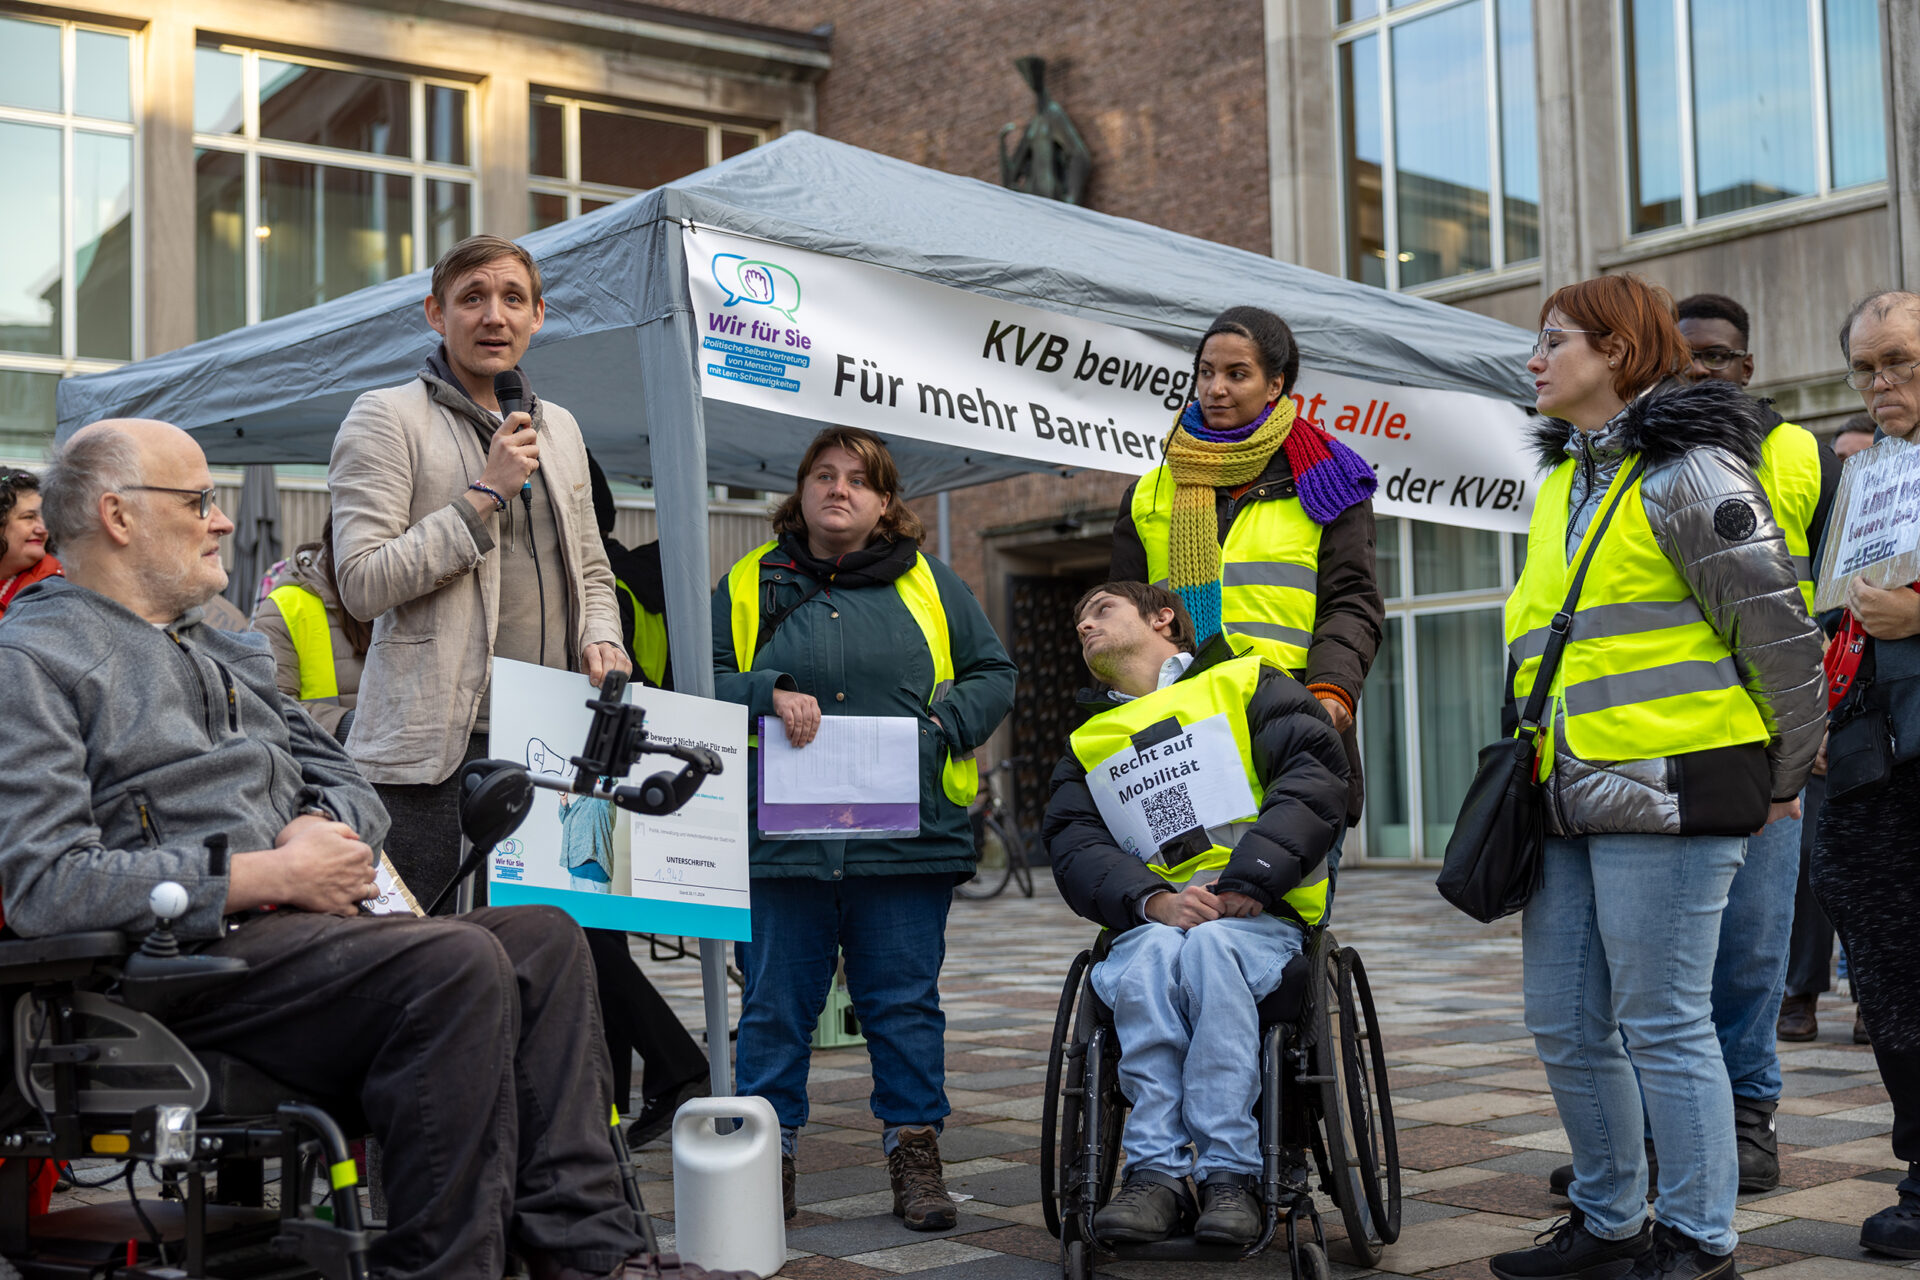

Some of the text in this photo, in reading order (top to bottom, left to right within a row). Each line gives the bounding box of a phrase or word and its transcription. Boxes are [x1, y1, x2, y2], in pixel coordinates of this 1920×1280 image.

[709, 312, 811, 349] Wir für Sie
[704, 339, 808, 367] Politische Selbst-Vertretung
[728, 358, 783, 374] von Menschen
[709, 366, 798, 389] mit Lern-Schwierigkeiten
[983, 320, 1069, 373] KVB
[1074, 340, 1197, 411] beweg
[1334, 400, 1411, 441] alle.
[834, 354, 904, 407] Für
[917, 382, 1018, 432] mehr
[1029, 402, 1166, 460] Barrier
[1386, 468, 1445, 504] der
[1450, 475, 1526, 511] KVB!
[650, 732, 672, 745] bewegt
[710, 743, 721, 752] Für
[721, 746, 738, 754] mehr
[1109, 733, 1193, 782] Recht auf
[1118, 760, 1200, 805] Mobilität
[666, 856, 717, 868] UNTERSCHRIFTEN:
